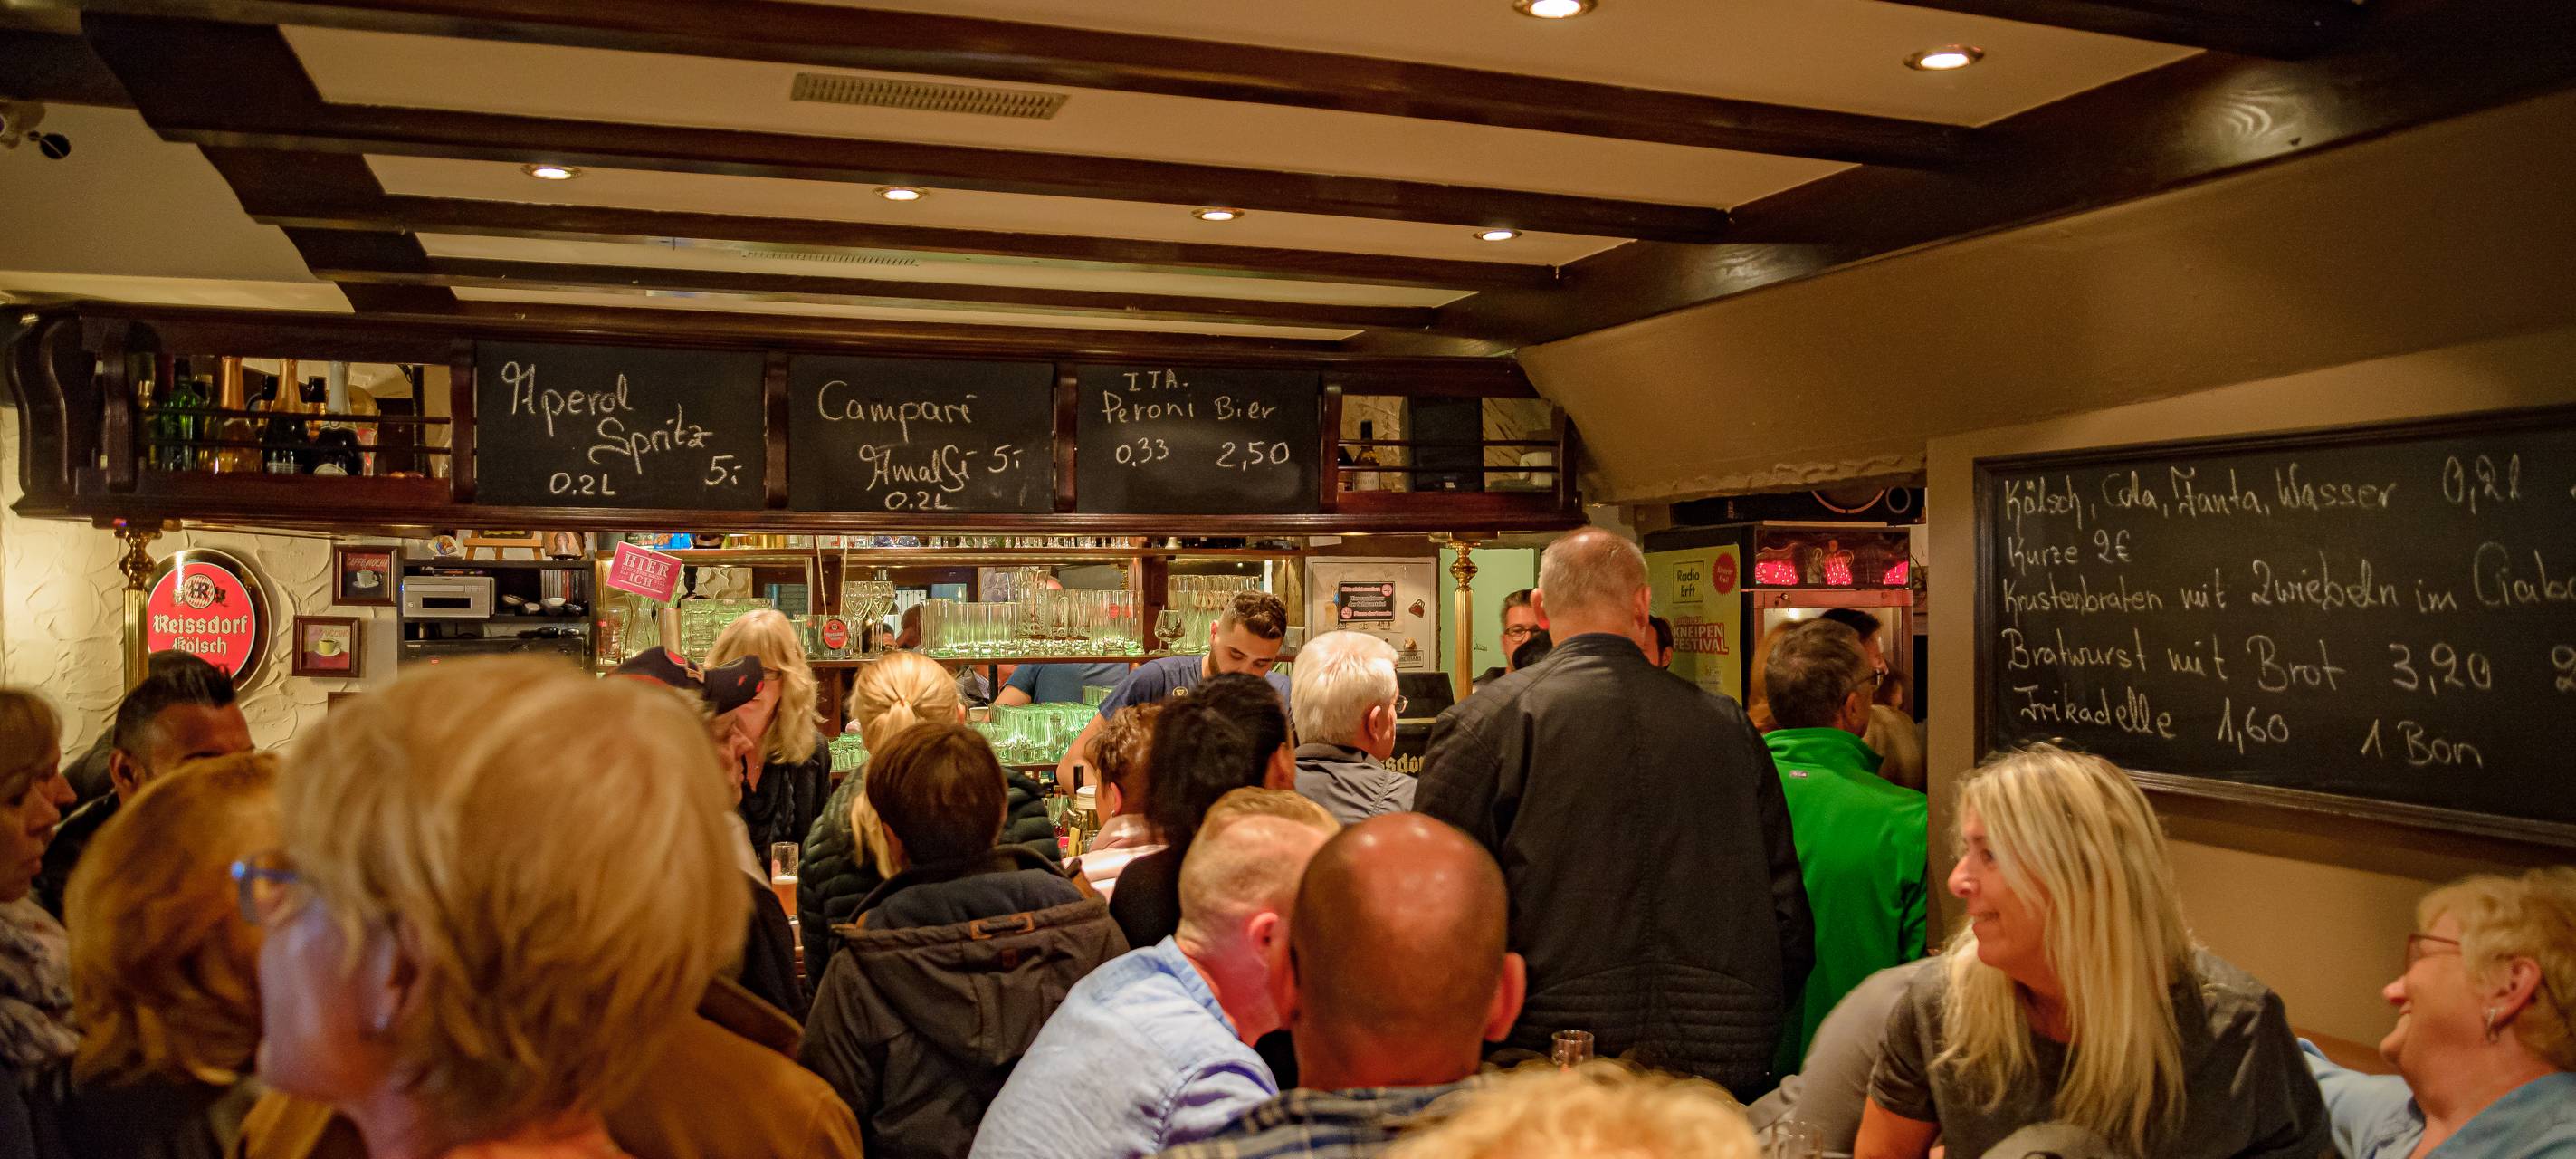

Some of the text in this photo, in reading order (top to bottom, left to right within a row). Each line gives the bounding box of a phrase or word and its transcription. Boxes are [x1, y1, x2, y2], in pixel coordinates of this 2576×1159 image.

[1121, 368, 1188, 391] ITA.
[501, 360, 635, 437] Aperol
[818, 379, 978, 444] Campari
[1101, 390, 1278, 424] Peroni Bier
[587, 402, 714, 475] Spritz
[858, 444, 978, 493] Amalfi
[1216, 440, 1290, 472] 2,50
[2275, 462, 2398, 511] Wasser
[622, 552, 670, 578] HIER
[2007, 528, 2132, 577] Kurze 2€
[628, 572, 654, 588] ICH
[1676, 567, 1700, 582] Radio
[1680, 583, 1696, 598] Erft
[2002, 571, 2164, 628] Krustenbraten
[2180, 567, 2228, 610] mit
[2415, 578, 2458, 614] im
[152, 614, 249, 635] Reissdorf
[1673, 624, 1724, 638] KNEIPEN
[172, 635, 228, 656] Kölsch
[1673, 637, 1729, 654] FESTIVAL
[2000, 627, 2147, 673] Bratwurst
[2166, 632, 2229, 681] mit
[2245, 633, 2347, 693] Brot
[2012, 681, 2484, 769] Frikadelle 1,60 1 Bon
